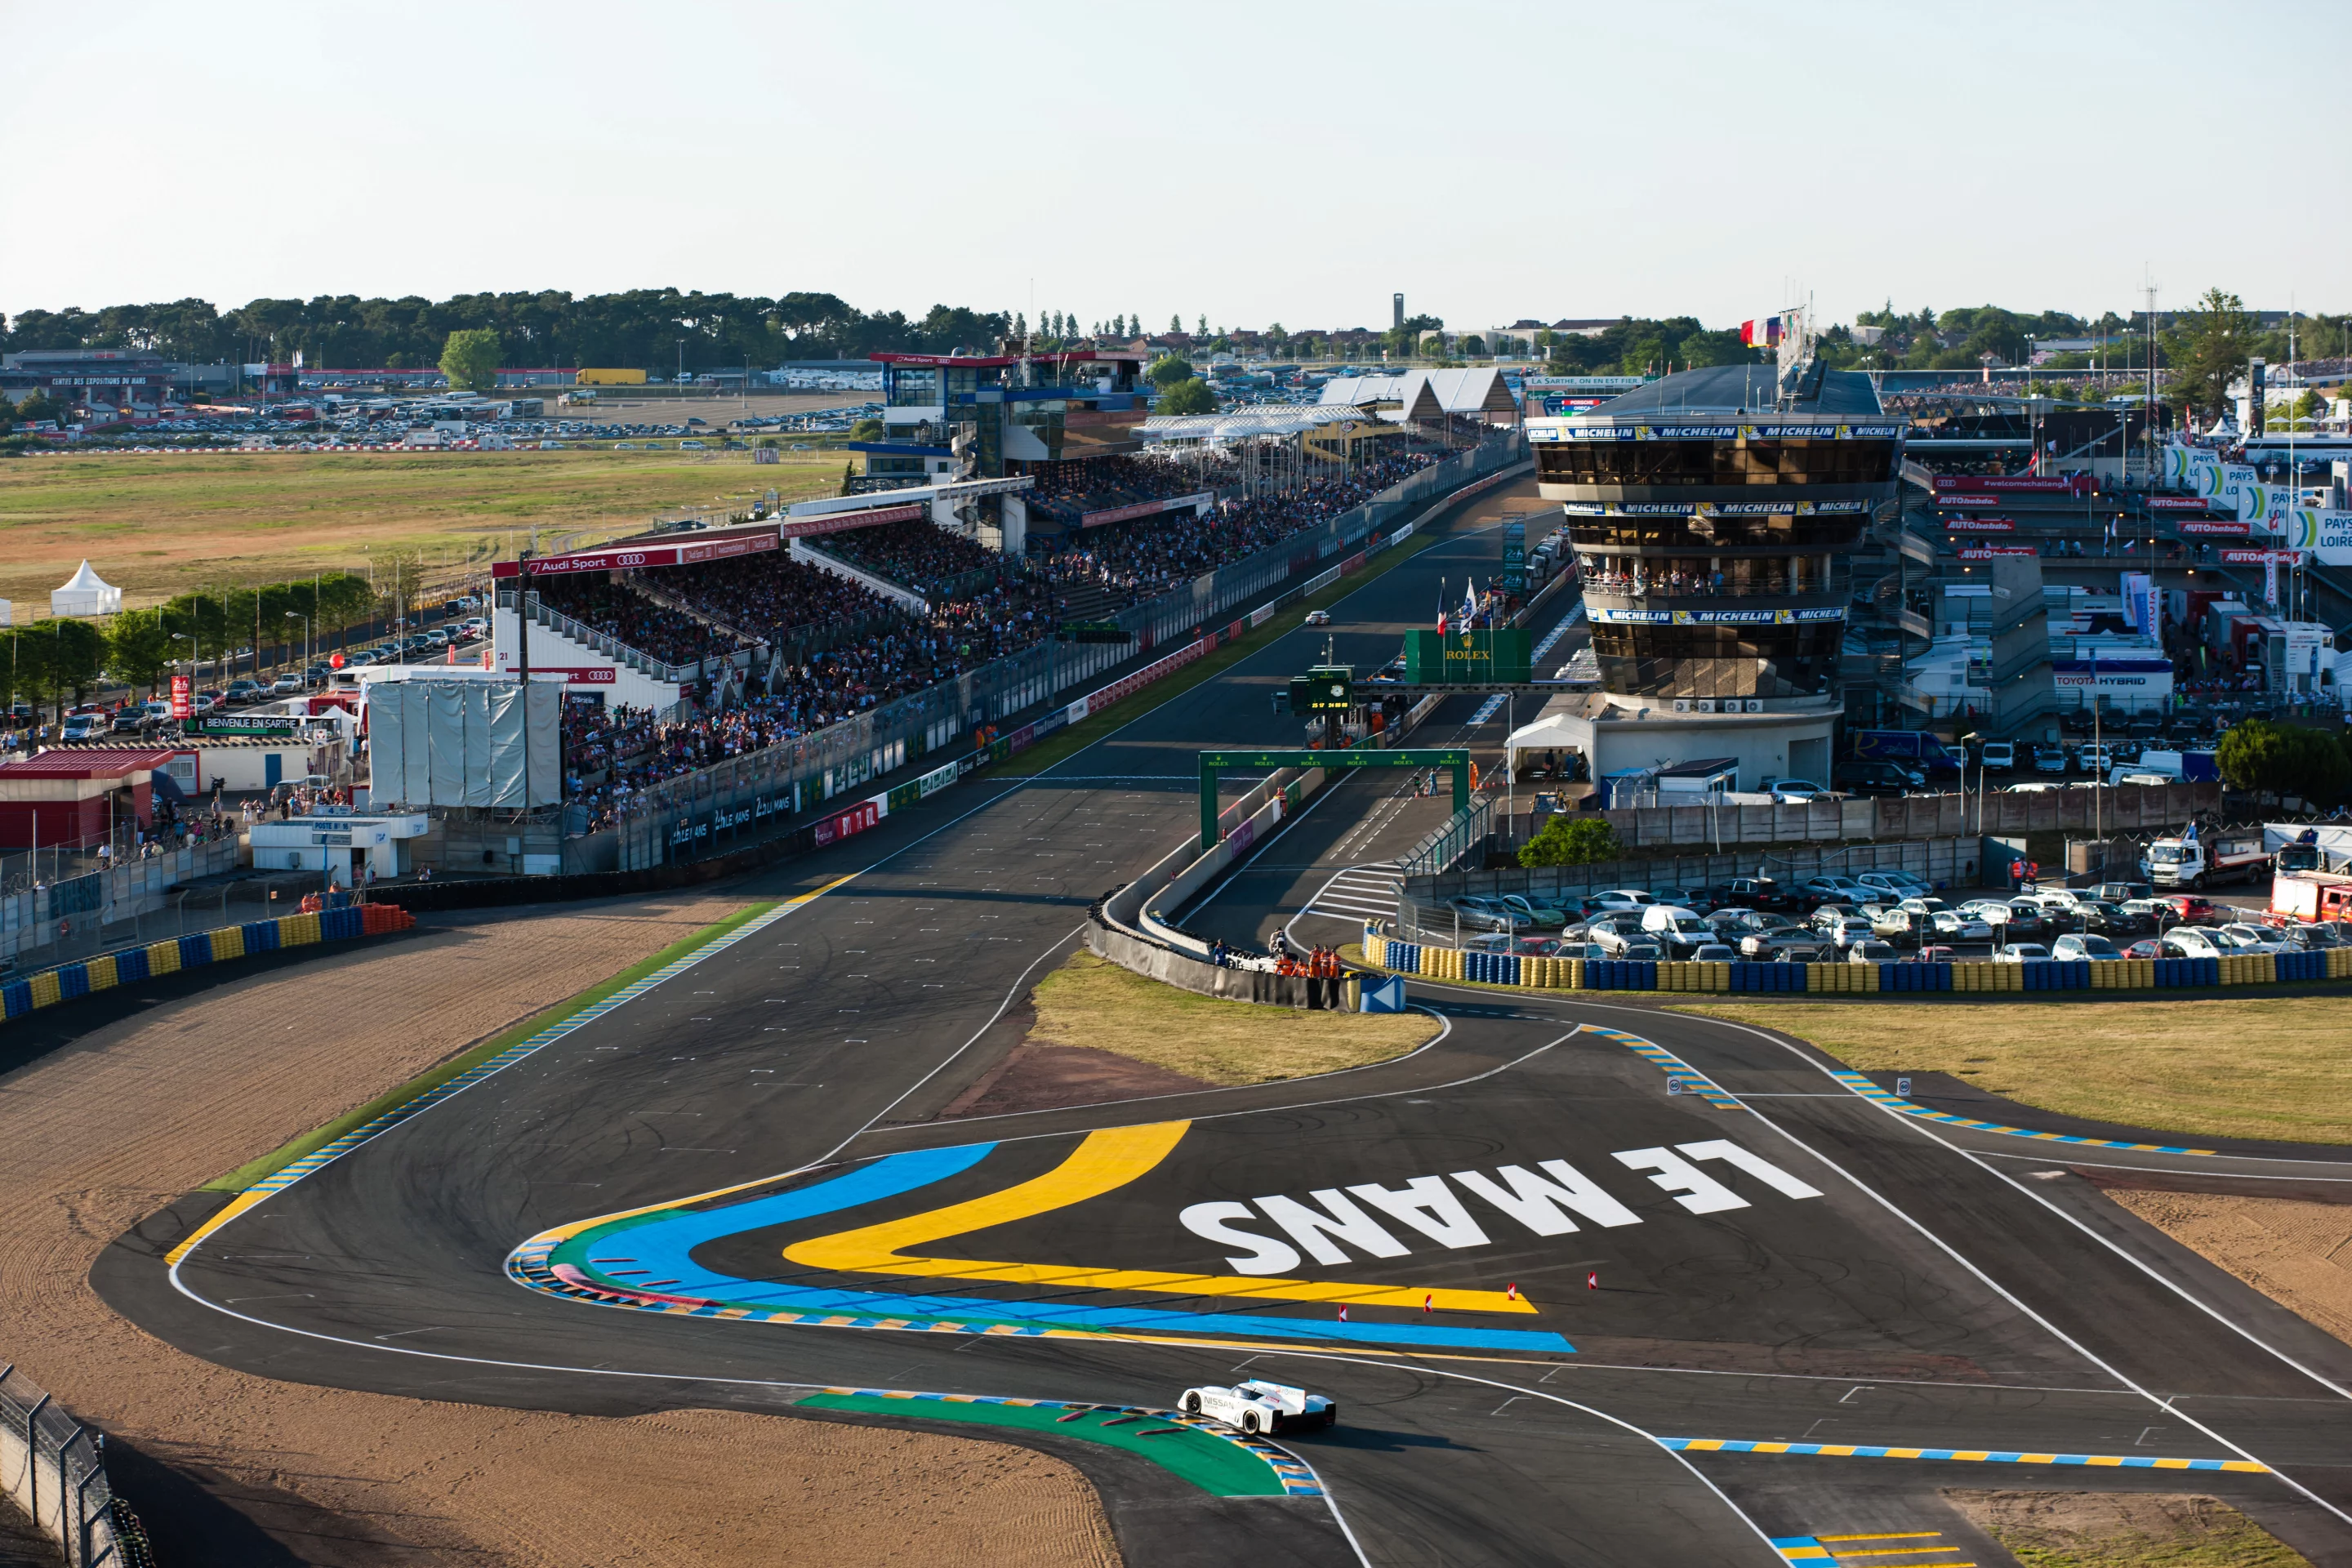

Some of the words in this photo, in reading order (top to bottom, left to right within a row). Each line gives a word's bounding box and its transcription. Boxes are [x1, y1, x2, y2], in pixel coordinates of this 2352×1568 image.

[1575, 428, 1633, 437] MICHELIN
[1662, 427, 1735, 437] MICHELIN
[1766, 427, 1835, 437] MICHELIN
[1856, 427, 1896, 436] MICHELIN
[2193, 455, 2215, 464] PAYS
[2229, 472, 2253, 480] PAYS
[1626, 503, 1694, 512] MICHELIN
[1724, 503, 1794, 512] MICHELIN
[1819, 501, 1862, 511] MICHELIN
[542, 560, 569, 572] Audi
[572, 558, 606, 570] Sport
[1612, 611, 1670, 621] MICHELIN
[1700, 611, 1773, 621] MICHELIN
[1798, 609, 1842, 619] MICHELIN
[499, 653, 508, 661] 21
[1446, 650, 1490, 660] ROLEX
[2056, 677, 2097, 685] TOYOTA
[207, 718, 250, 728] BIENVENUE
[252, 719, 263, 728] EN
[265, 719, 296, 729] SARTHE
[1610, 1139, 1824, 1215] LE
[1179, 1159, 1644, 1275] MANS
[1204, 1396, 1234, 1410] NISSAN
